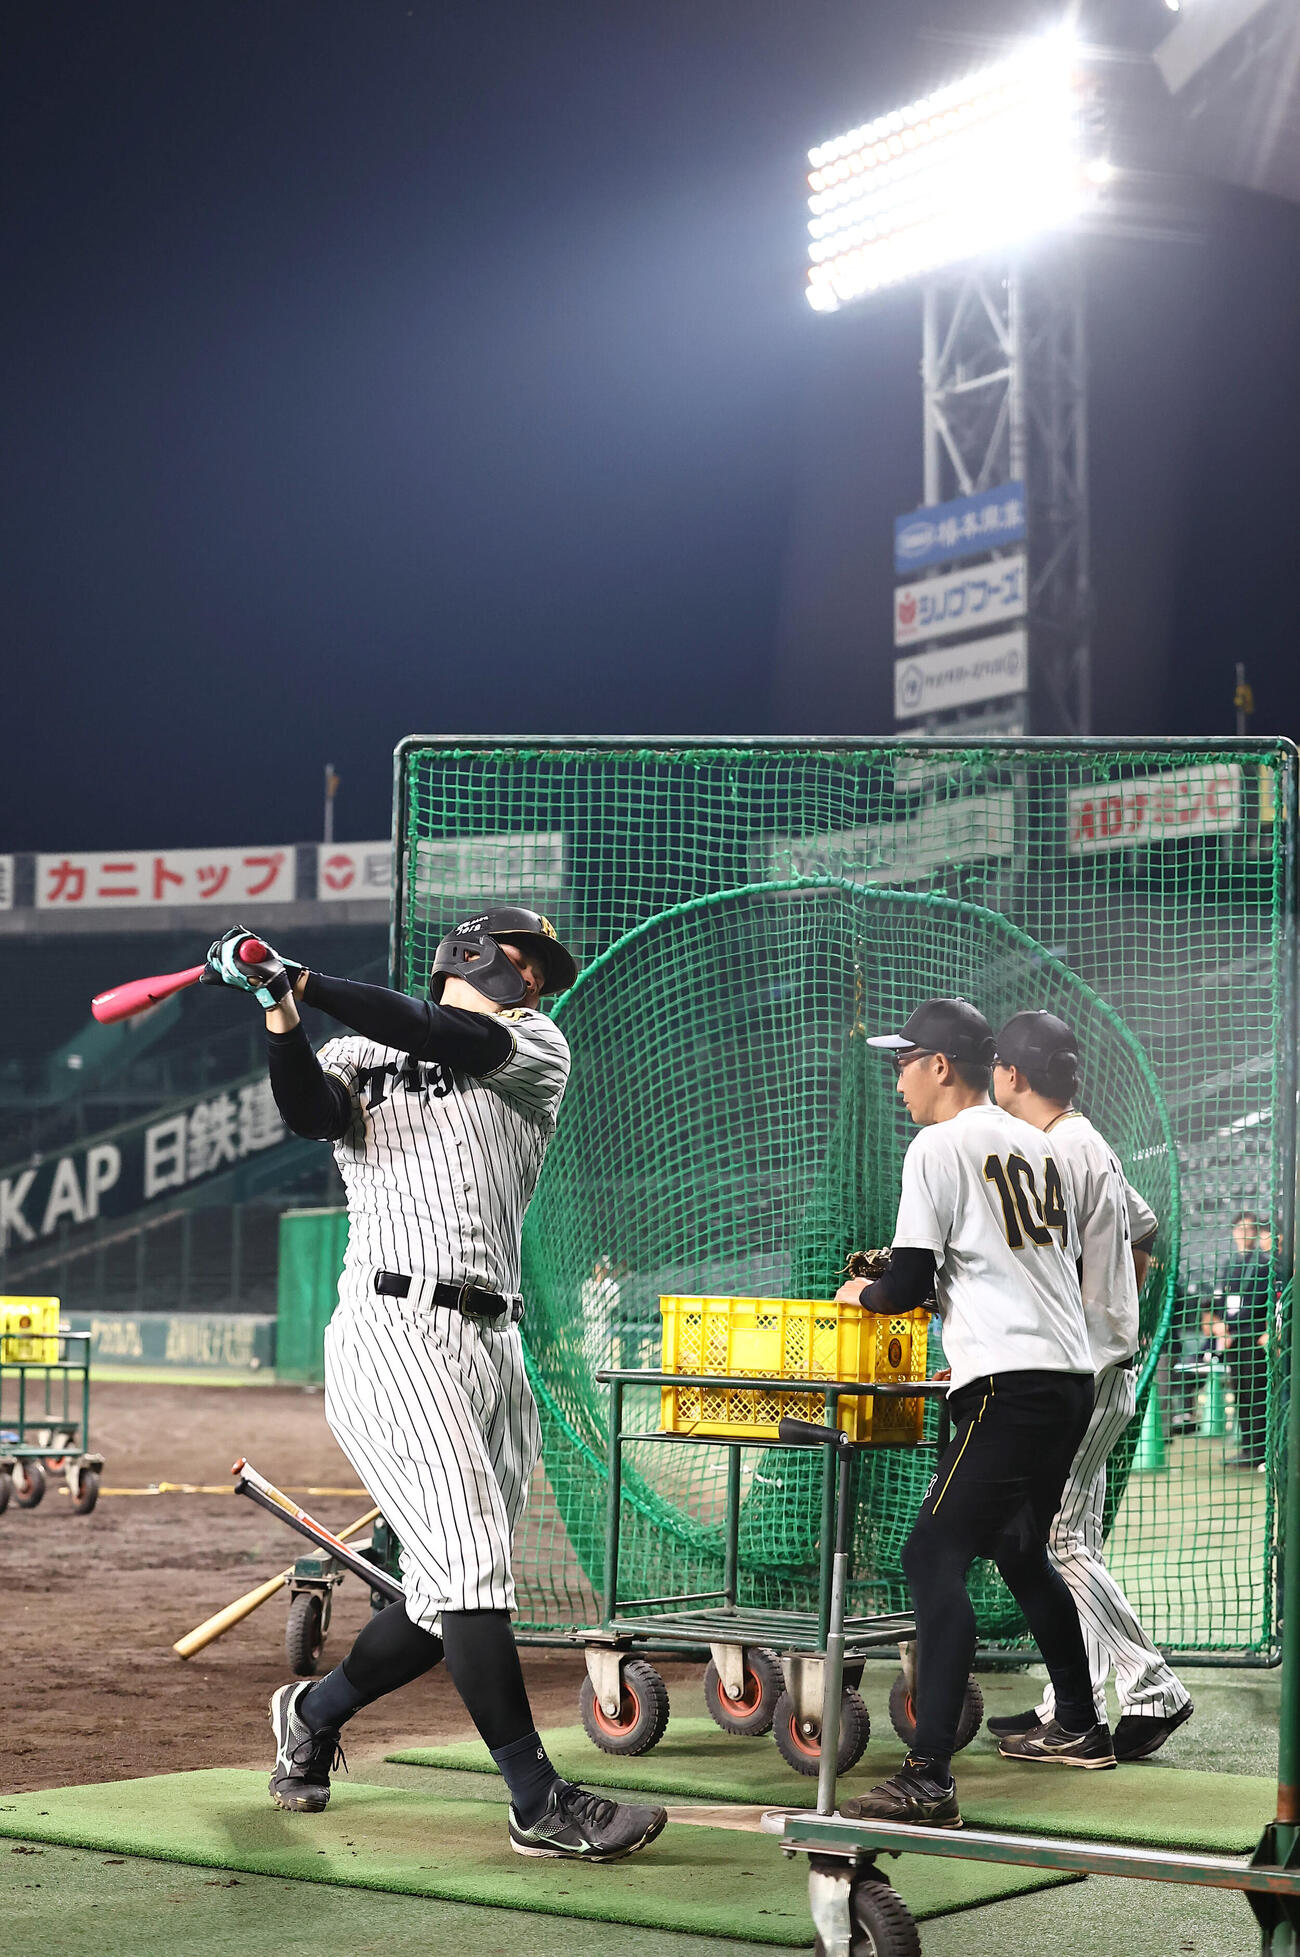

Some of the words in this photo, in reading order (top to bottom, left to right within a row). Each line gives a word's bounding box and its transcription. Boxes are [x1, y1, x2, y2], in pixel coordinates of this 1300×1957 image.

[47, 851, 286, 901] カニトップ
[982, 1153, 1069, 1250] 104
